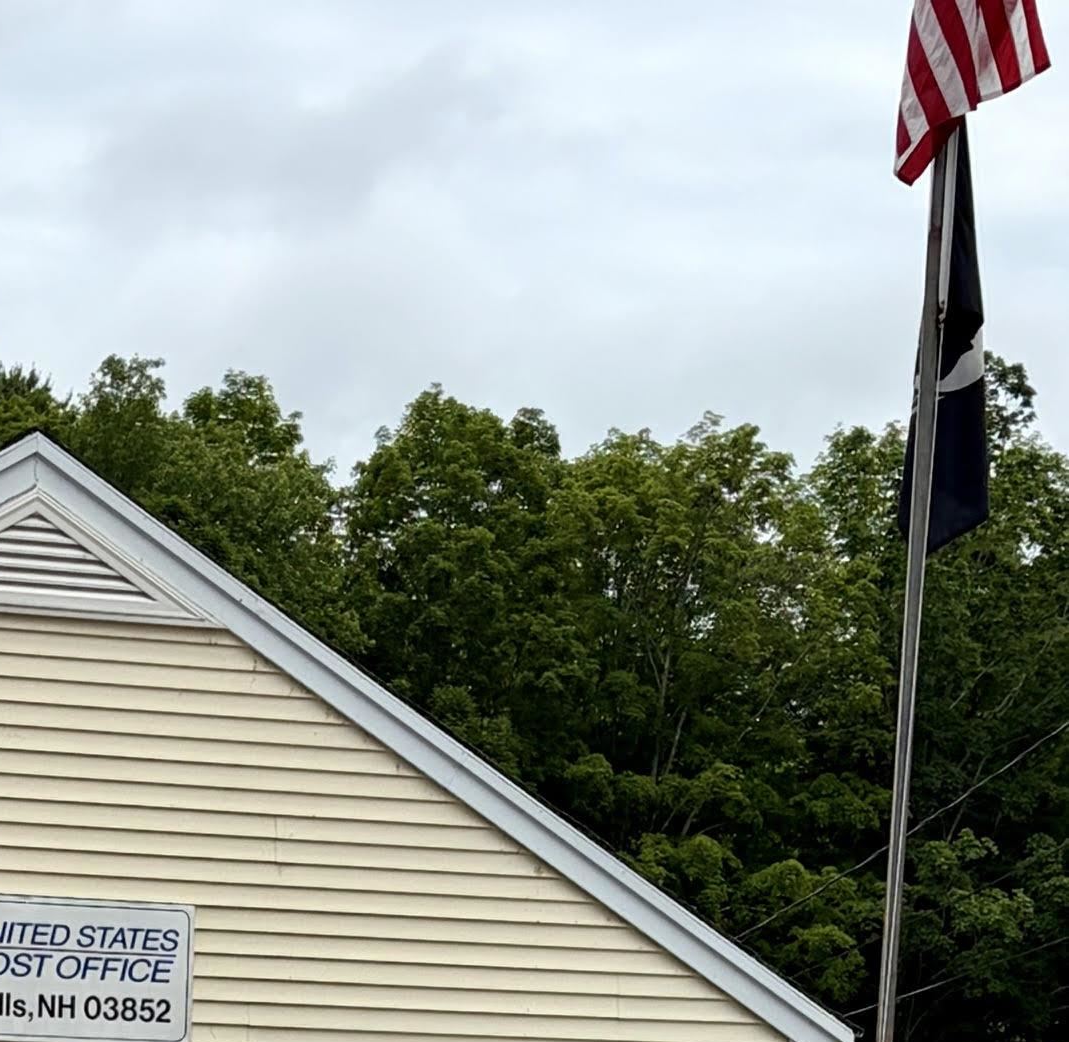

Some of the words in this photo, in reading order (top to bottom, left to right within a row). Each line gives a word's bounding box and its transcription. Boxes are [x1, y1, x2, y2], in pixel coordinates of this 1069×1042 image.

[76, 925, 179, 952] STATES
[56, 955, 174, 983] OFFICE
[84, 995, 172, 1023] 03852
